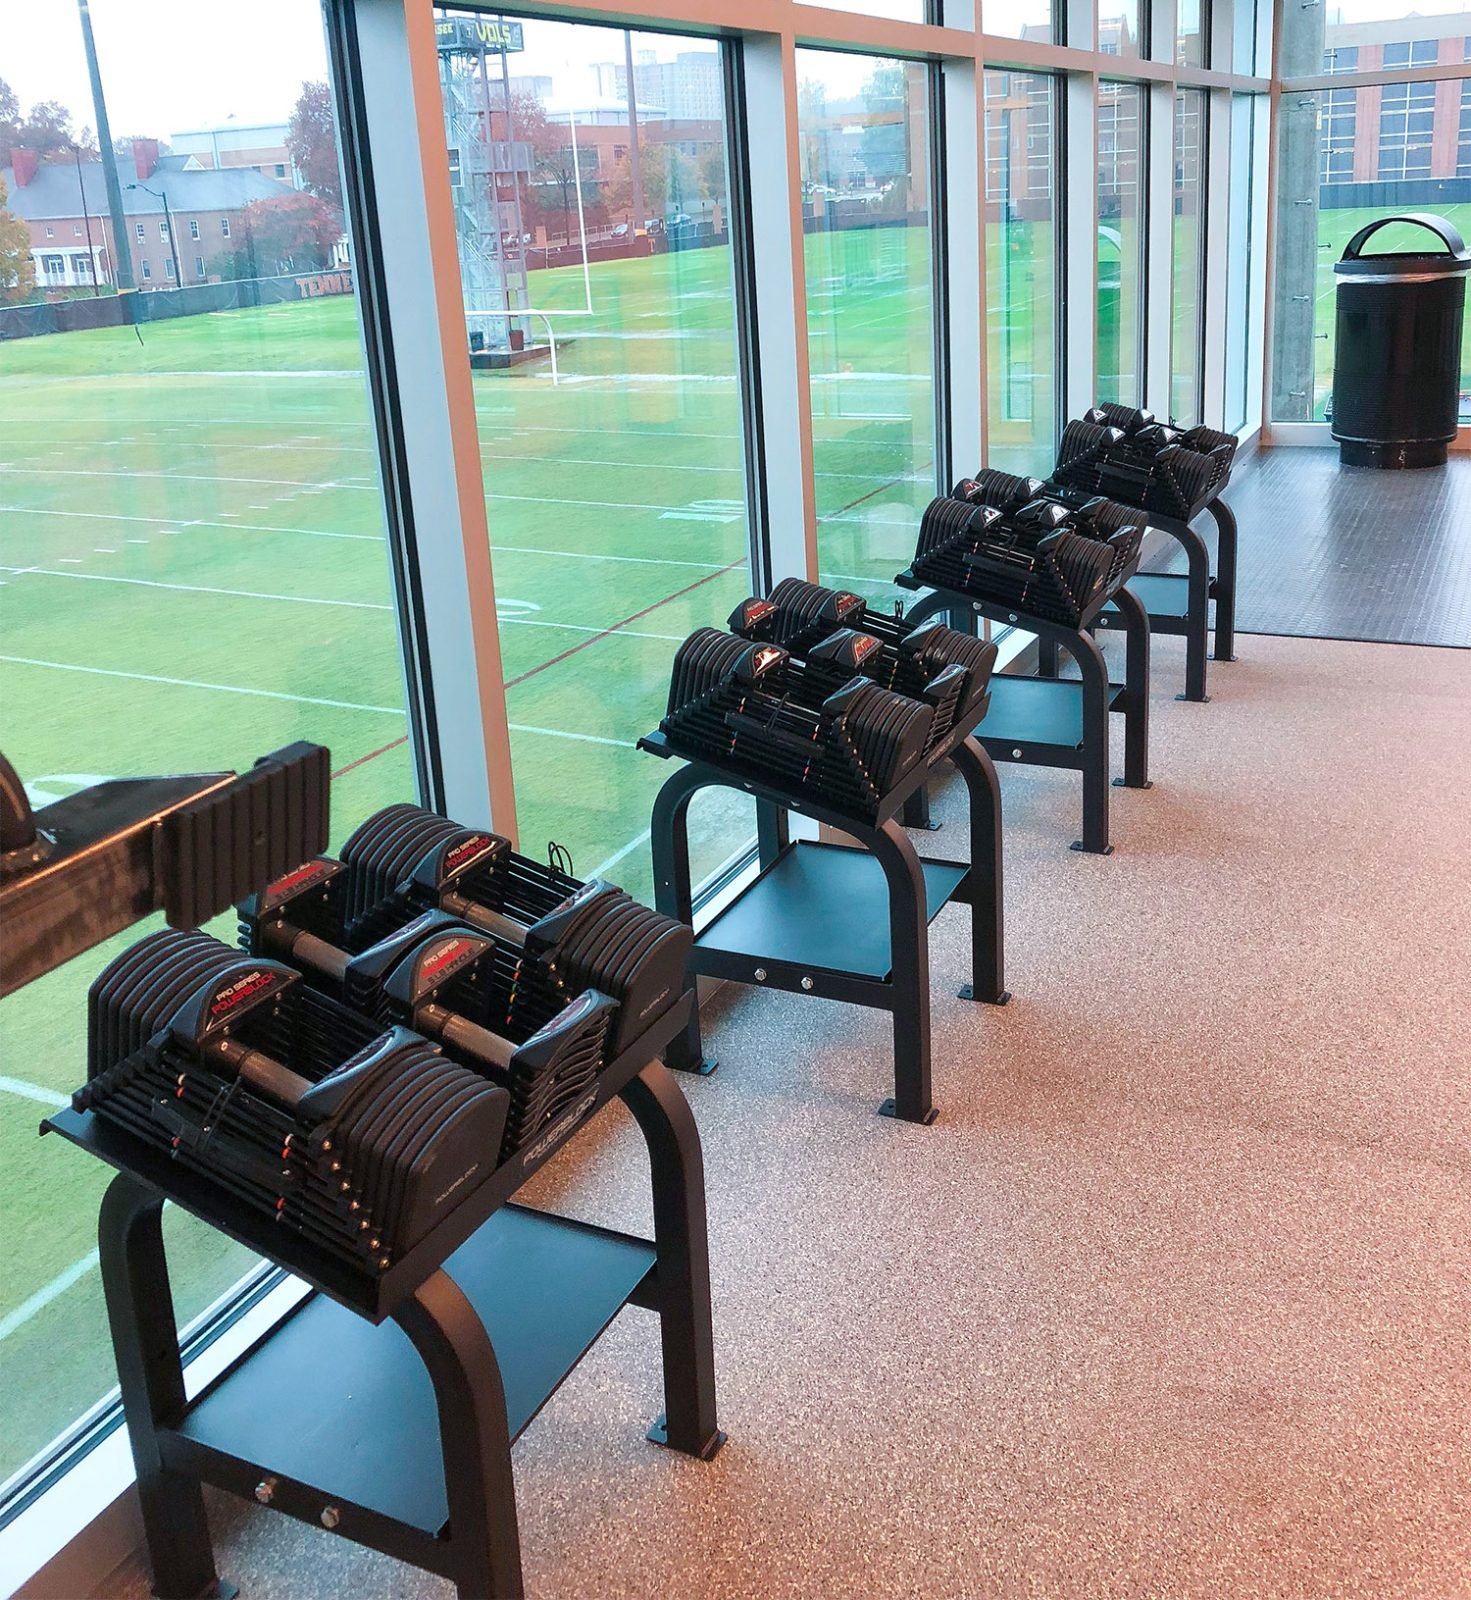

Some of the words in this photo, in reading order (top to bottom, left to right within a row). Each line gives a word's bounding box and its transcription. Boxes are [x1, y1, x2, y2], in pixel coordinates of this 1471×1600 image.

[434, 22, 454, 35] SEE
[475, 21, 512, 44] VOLS
[295, 271, 353, 299] TENNE
[211, 972, 273, 1015] POWERBLOCK
[216, 987, 234, 1001] PRO
[232, 971, 261, 992] SERIES
